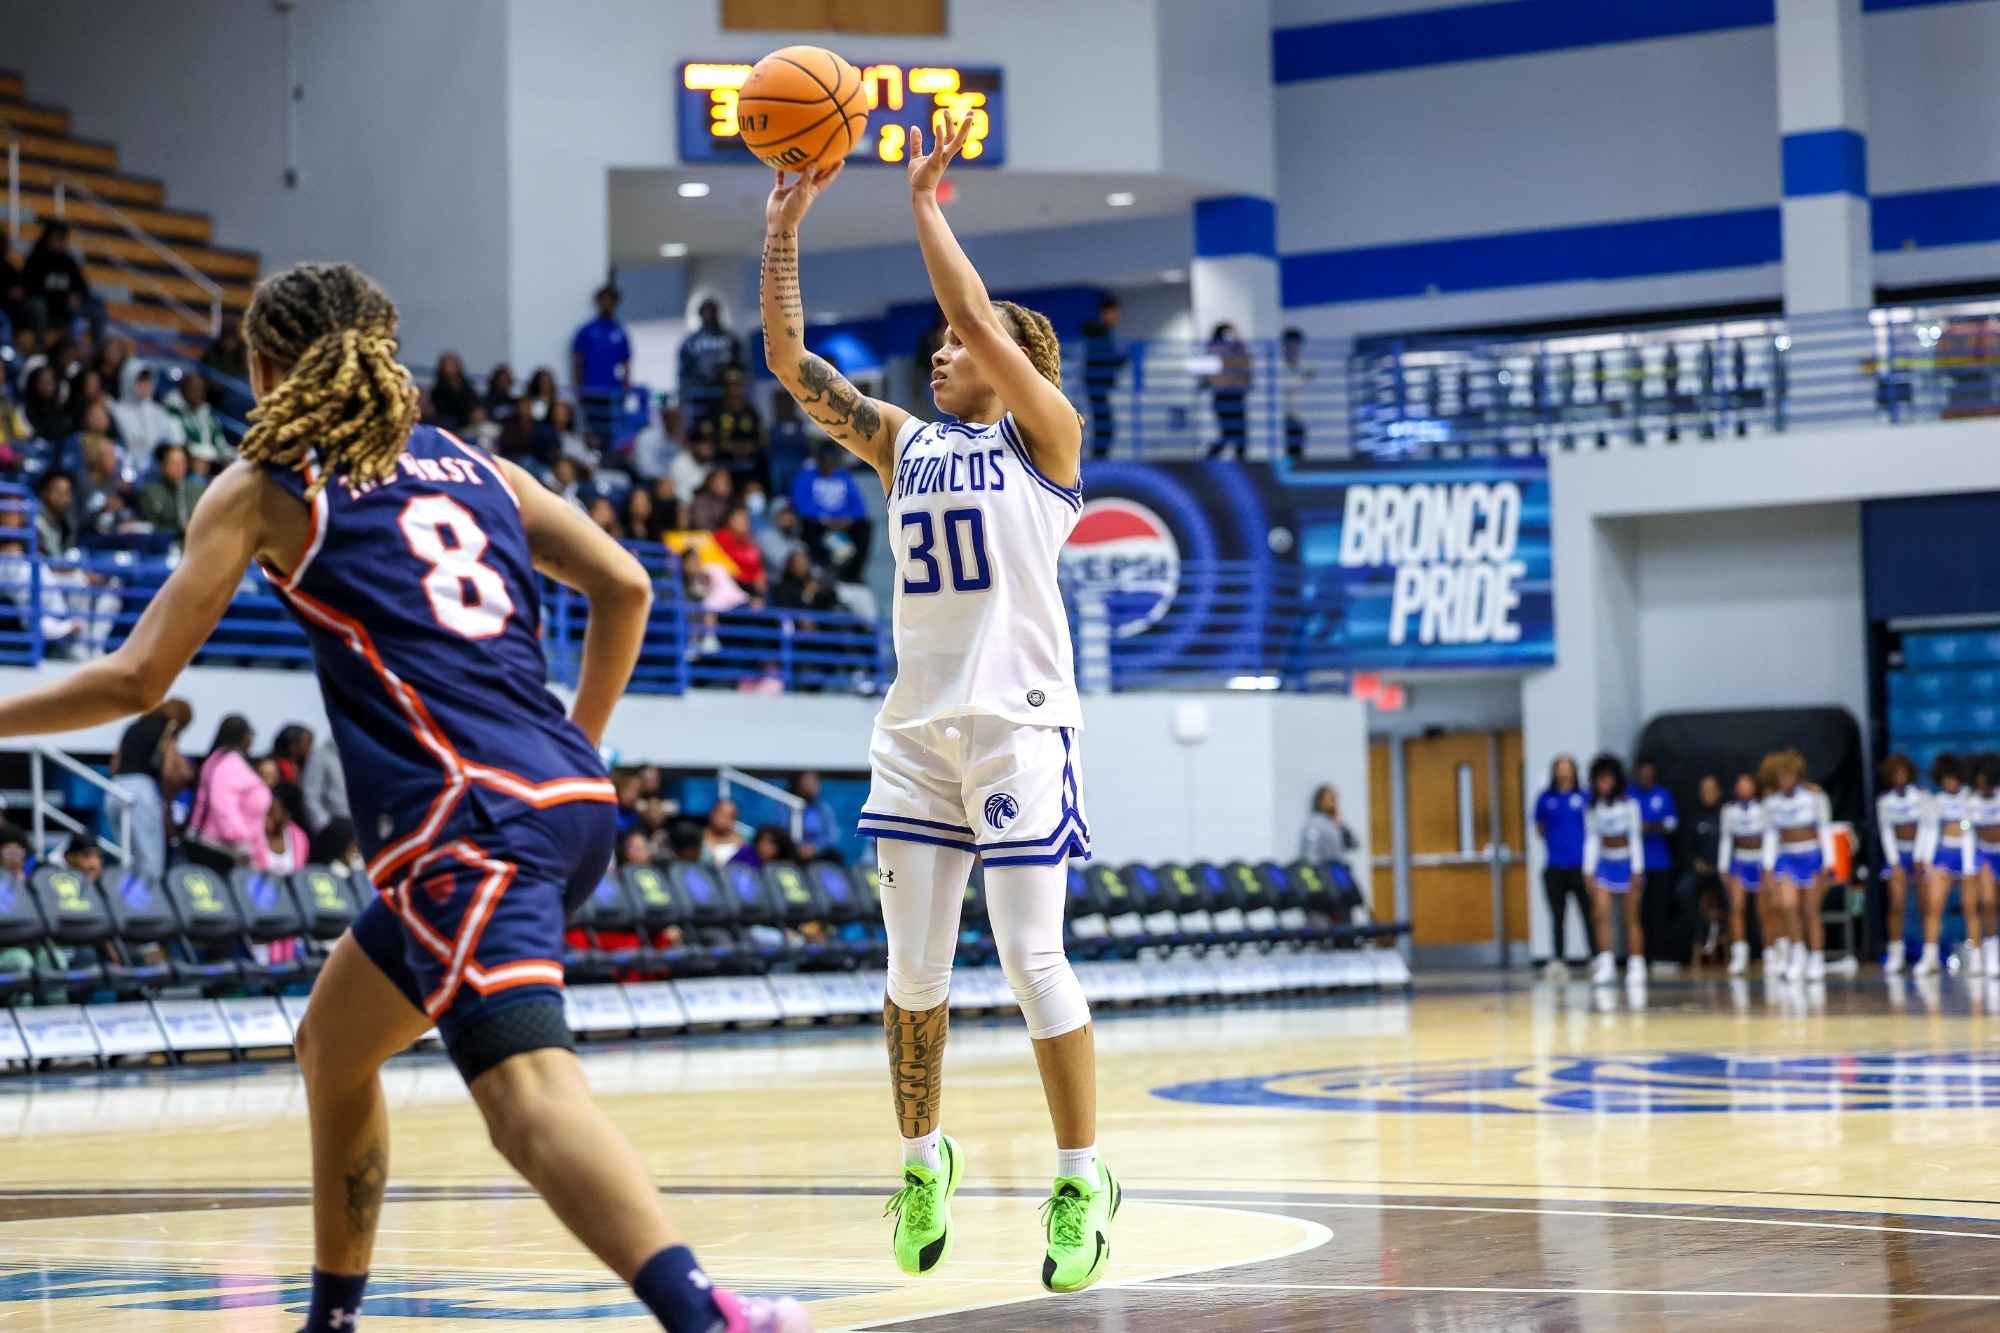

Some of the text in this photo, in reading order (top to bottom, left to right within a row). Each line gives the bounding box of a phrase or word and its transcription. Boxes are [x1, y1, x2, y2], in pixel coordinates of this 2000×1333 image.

[897, 449, 1005, 500] BRONCOS
[397, 493, 515, 640] 8
[901, 506, 993, 595] 30
[1338, 482, 1521, 567] BRONCO
[1389, 560, 1527, 645] PRIDE
